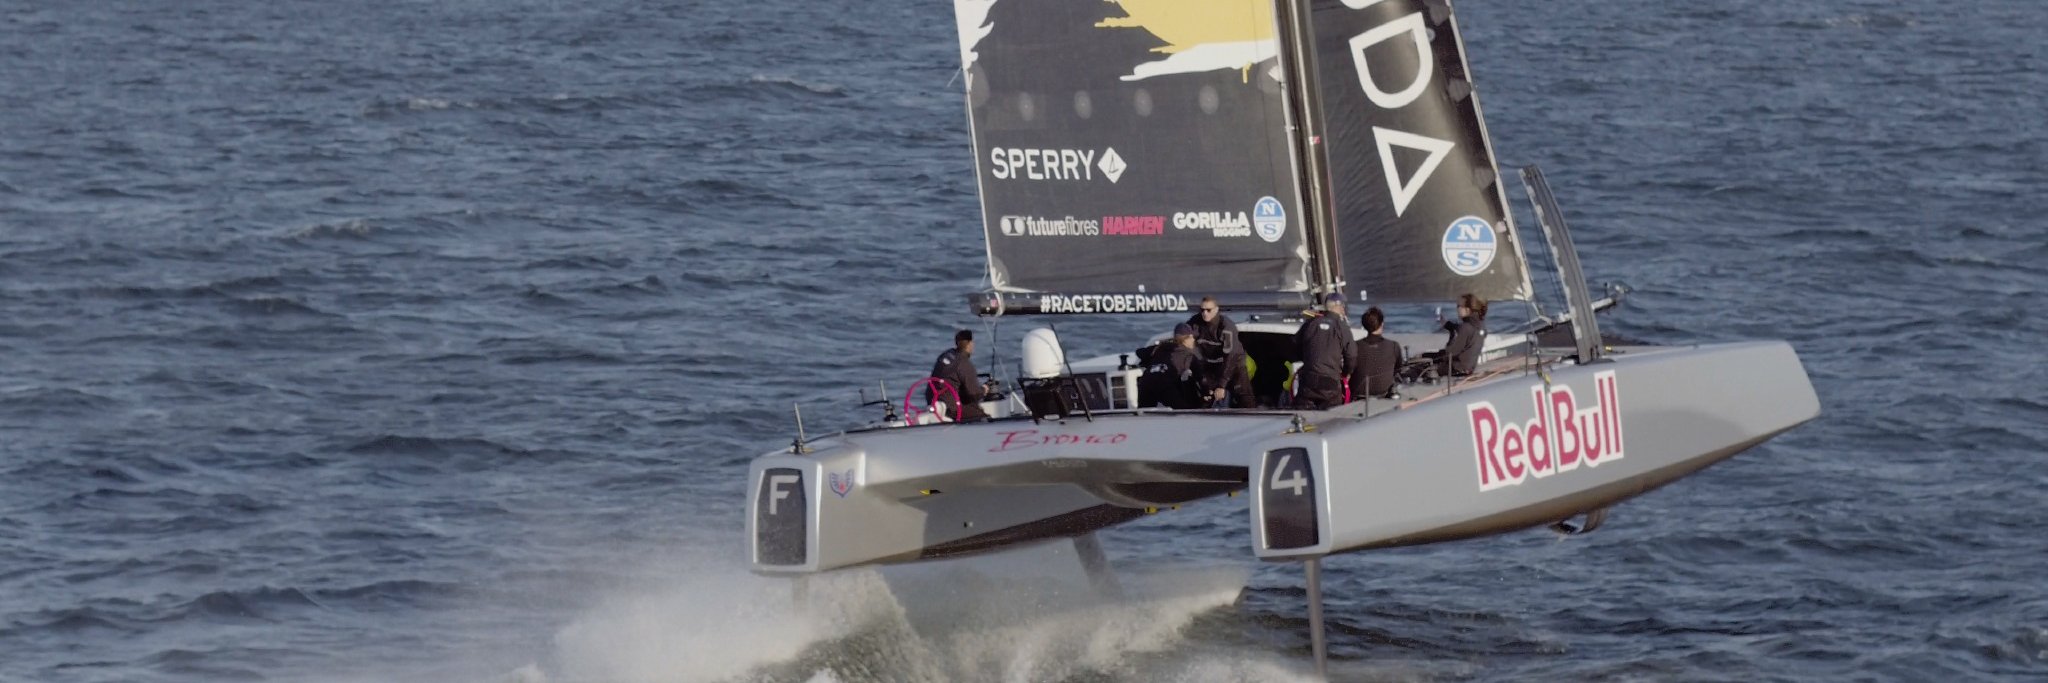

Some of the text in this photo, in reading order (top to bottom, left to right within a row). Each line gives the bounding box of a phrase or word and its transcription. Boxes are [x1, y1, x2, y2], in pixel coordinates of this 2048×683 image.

[1340, 0, 1456, 218] DA
[991, 147, 1095, 180] SPERRY
[1261, 203, 1276, 215] N
[1026, 216, 1099, 236] futurefibres
[1102, 216, 1164, 235] HARKEN
[1173, 212, 1250, 229] GORILLA
[1264, 224, 1277, 235] S
[1457, 224, 1483, 240] N
[1457, 251, 1479, 266] S
[1040, 294, 1188, 313] #RACETOBERMUDA
[988, 429, 1128, 452] Bronco
[1470, 376, 1621, 486] Red Bull
[1271, 454, 1308, 495] 4
[769, 475, 800, 515] F
